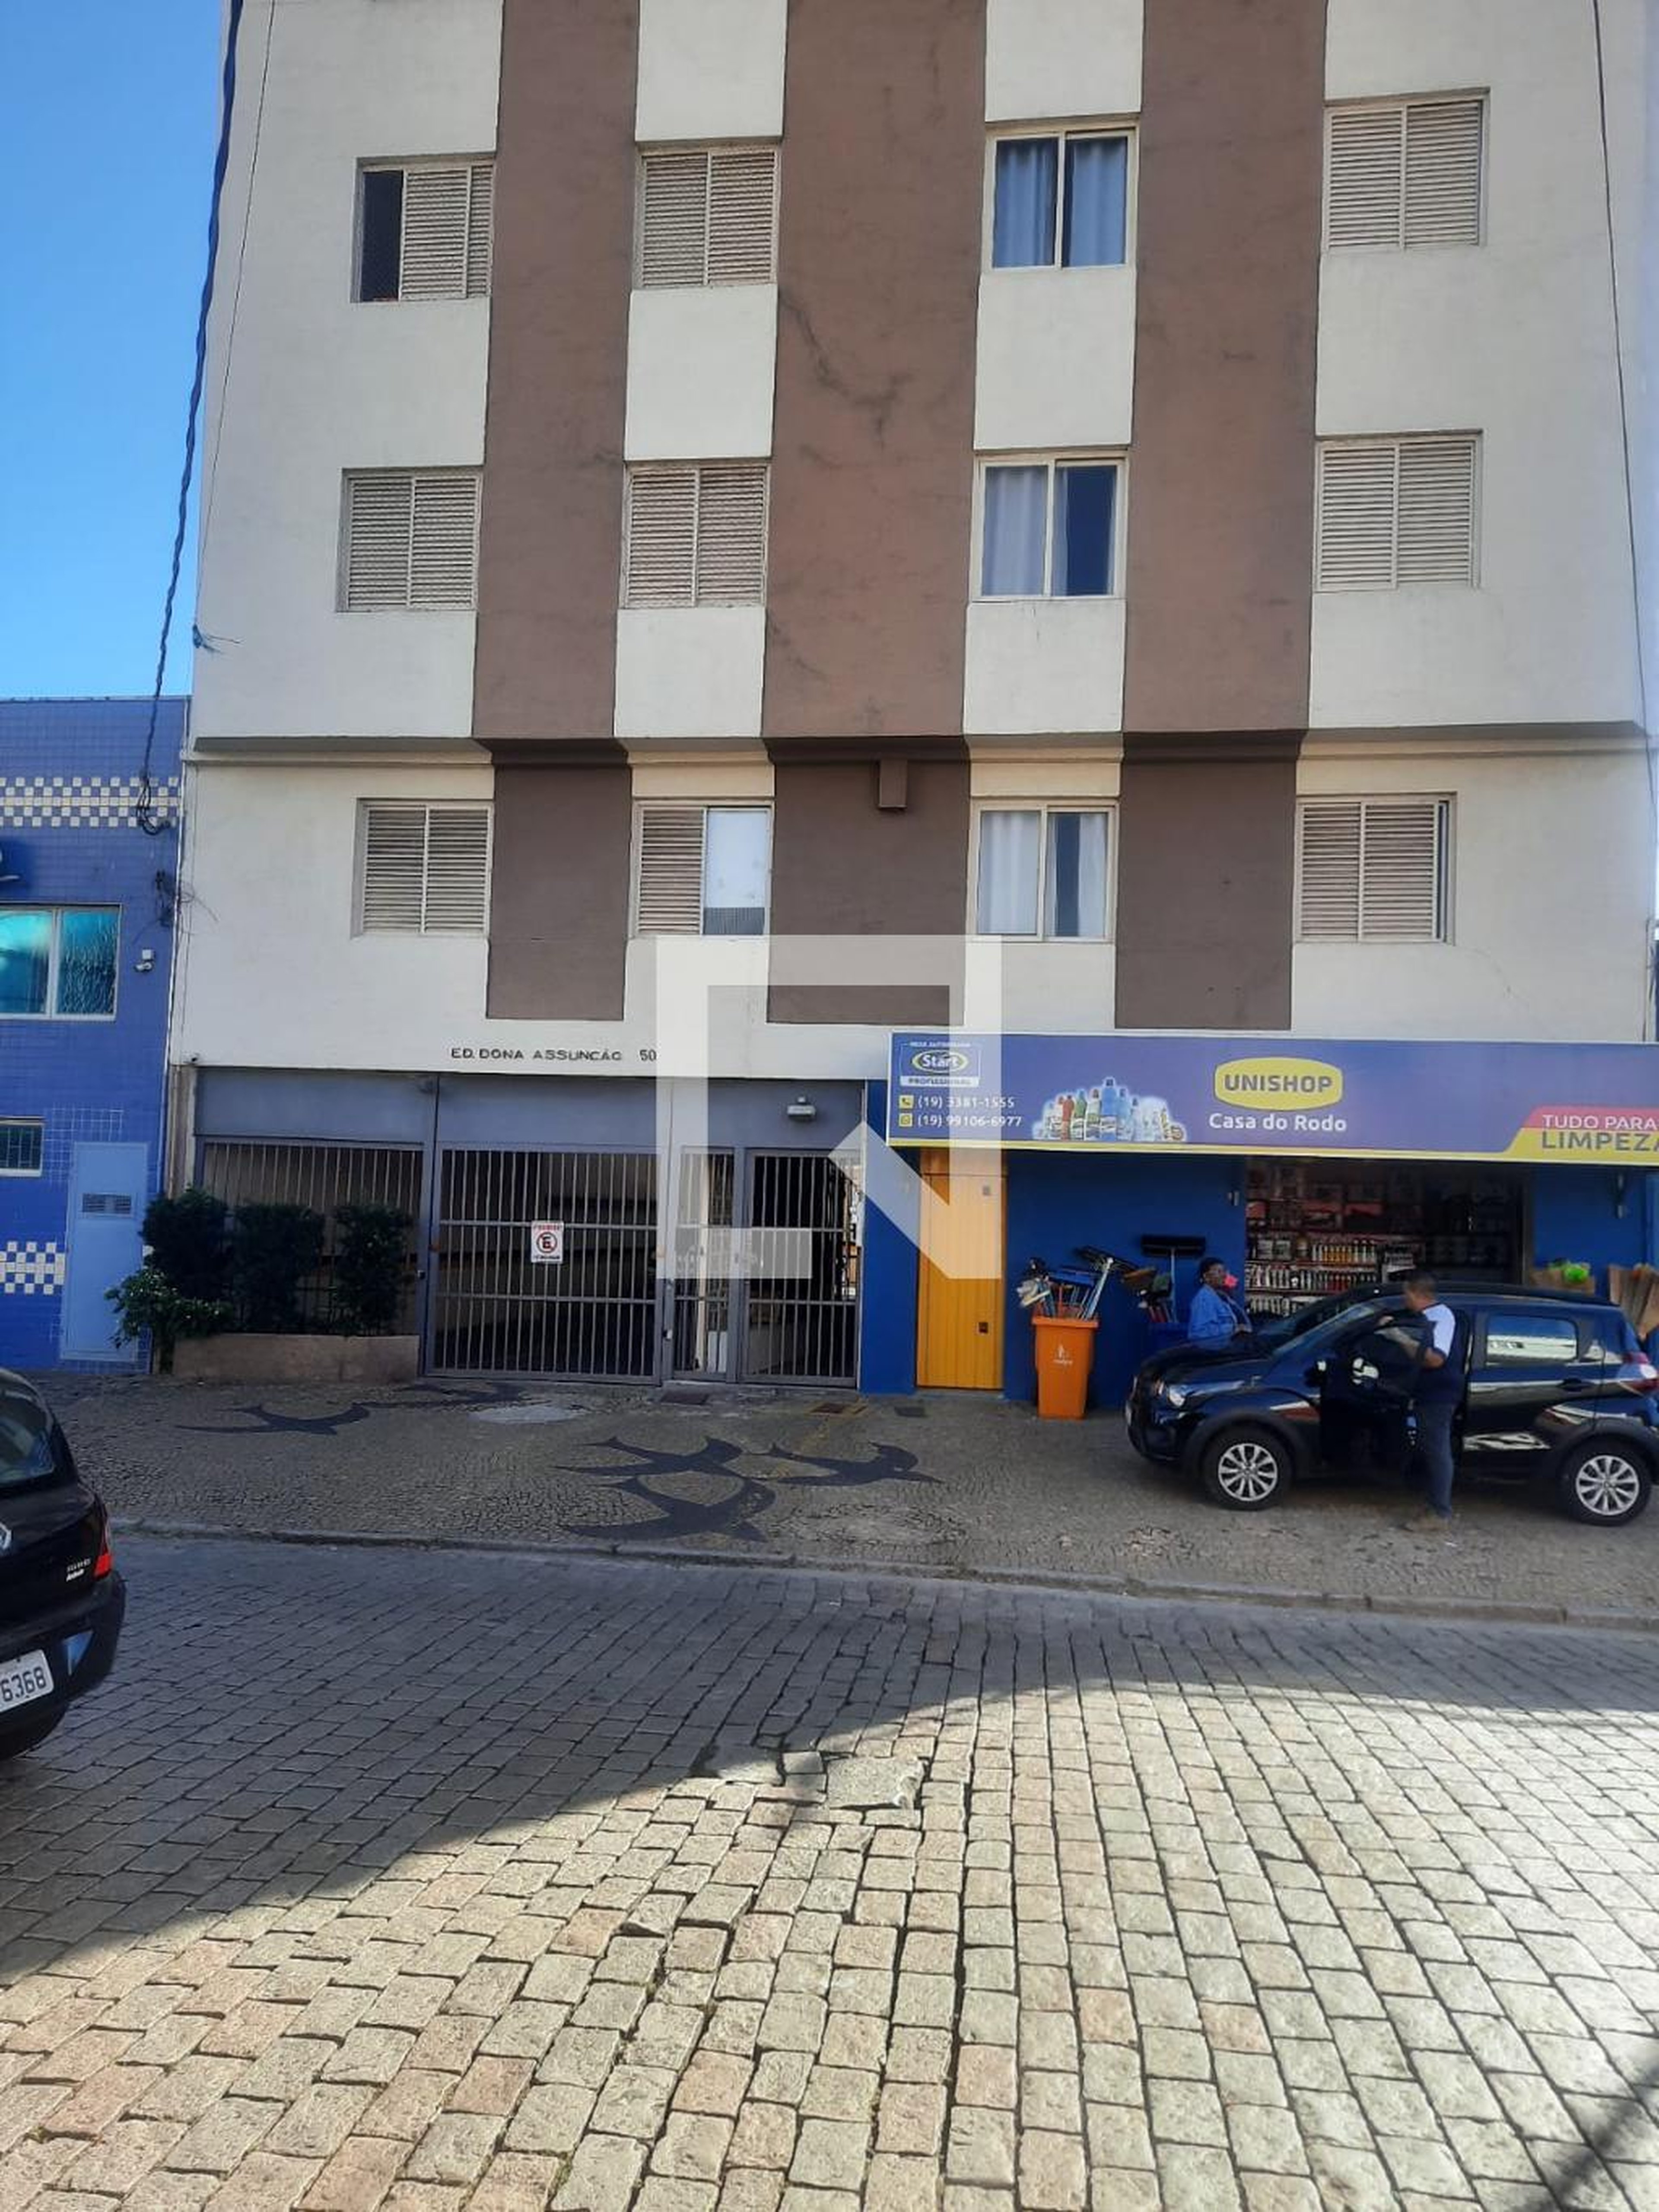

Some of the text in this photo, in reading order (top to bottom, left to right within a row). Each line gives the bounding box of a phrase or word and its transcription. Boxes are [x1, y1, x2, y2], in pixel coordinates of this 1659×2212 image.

[479, 1048, 524, 1059] DONA
[639, 1049, 657, 1062] 50
[922, 1054, 959, 1067] Start
[1224, 1074, 1332, 1093] UNISHOP
[918, 1095, 943, 1109] (19)
[918, 1114, 942, 1128] (19)
[1209, 1112, 1347, 1131] Casa do Rodo
[1541, 1114, 1657, 1130] TUDO PARA
[1, 1667, 46, 1702] 6368
